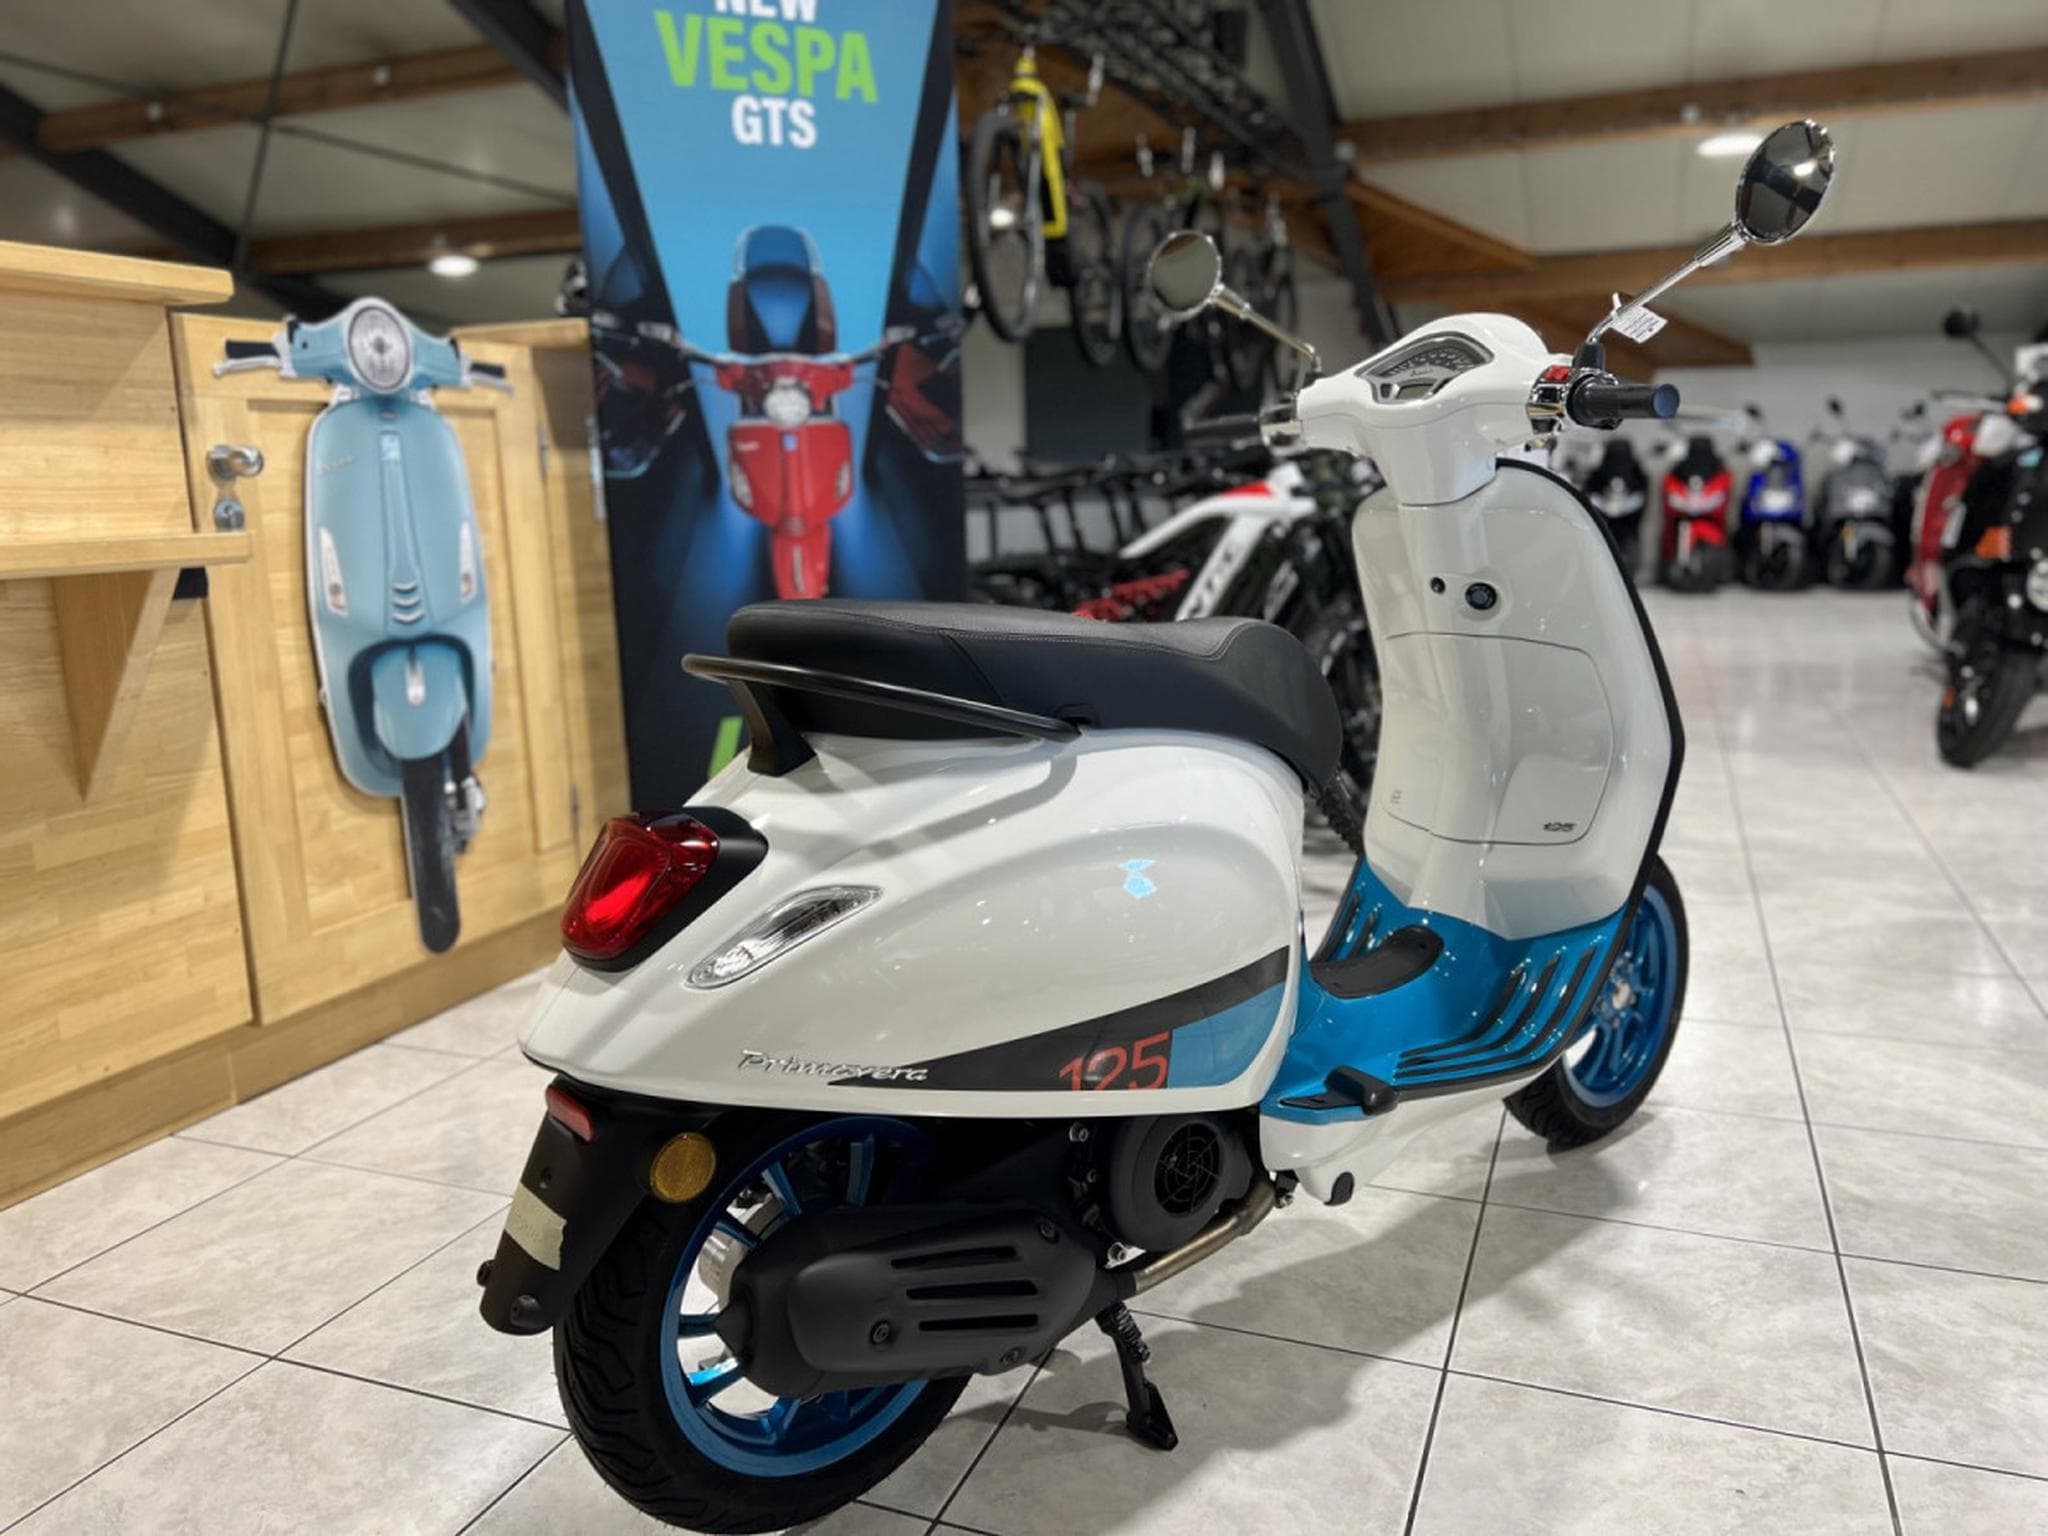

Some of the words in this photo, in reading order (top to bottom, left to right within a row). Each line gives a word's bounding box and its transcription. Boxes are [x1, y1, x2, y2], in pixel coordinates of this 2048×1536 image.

[655, 11, 878, 103] VESPA
[731, 95, 817, 148] GTS
[738, 1050, 928, 1080] Primavera
[1059, 1031, 1169, 1091] 125
